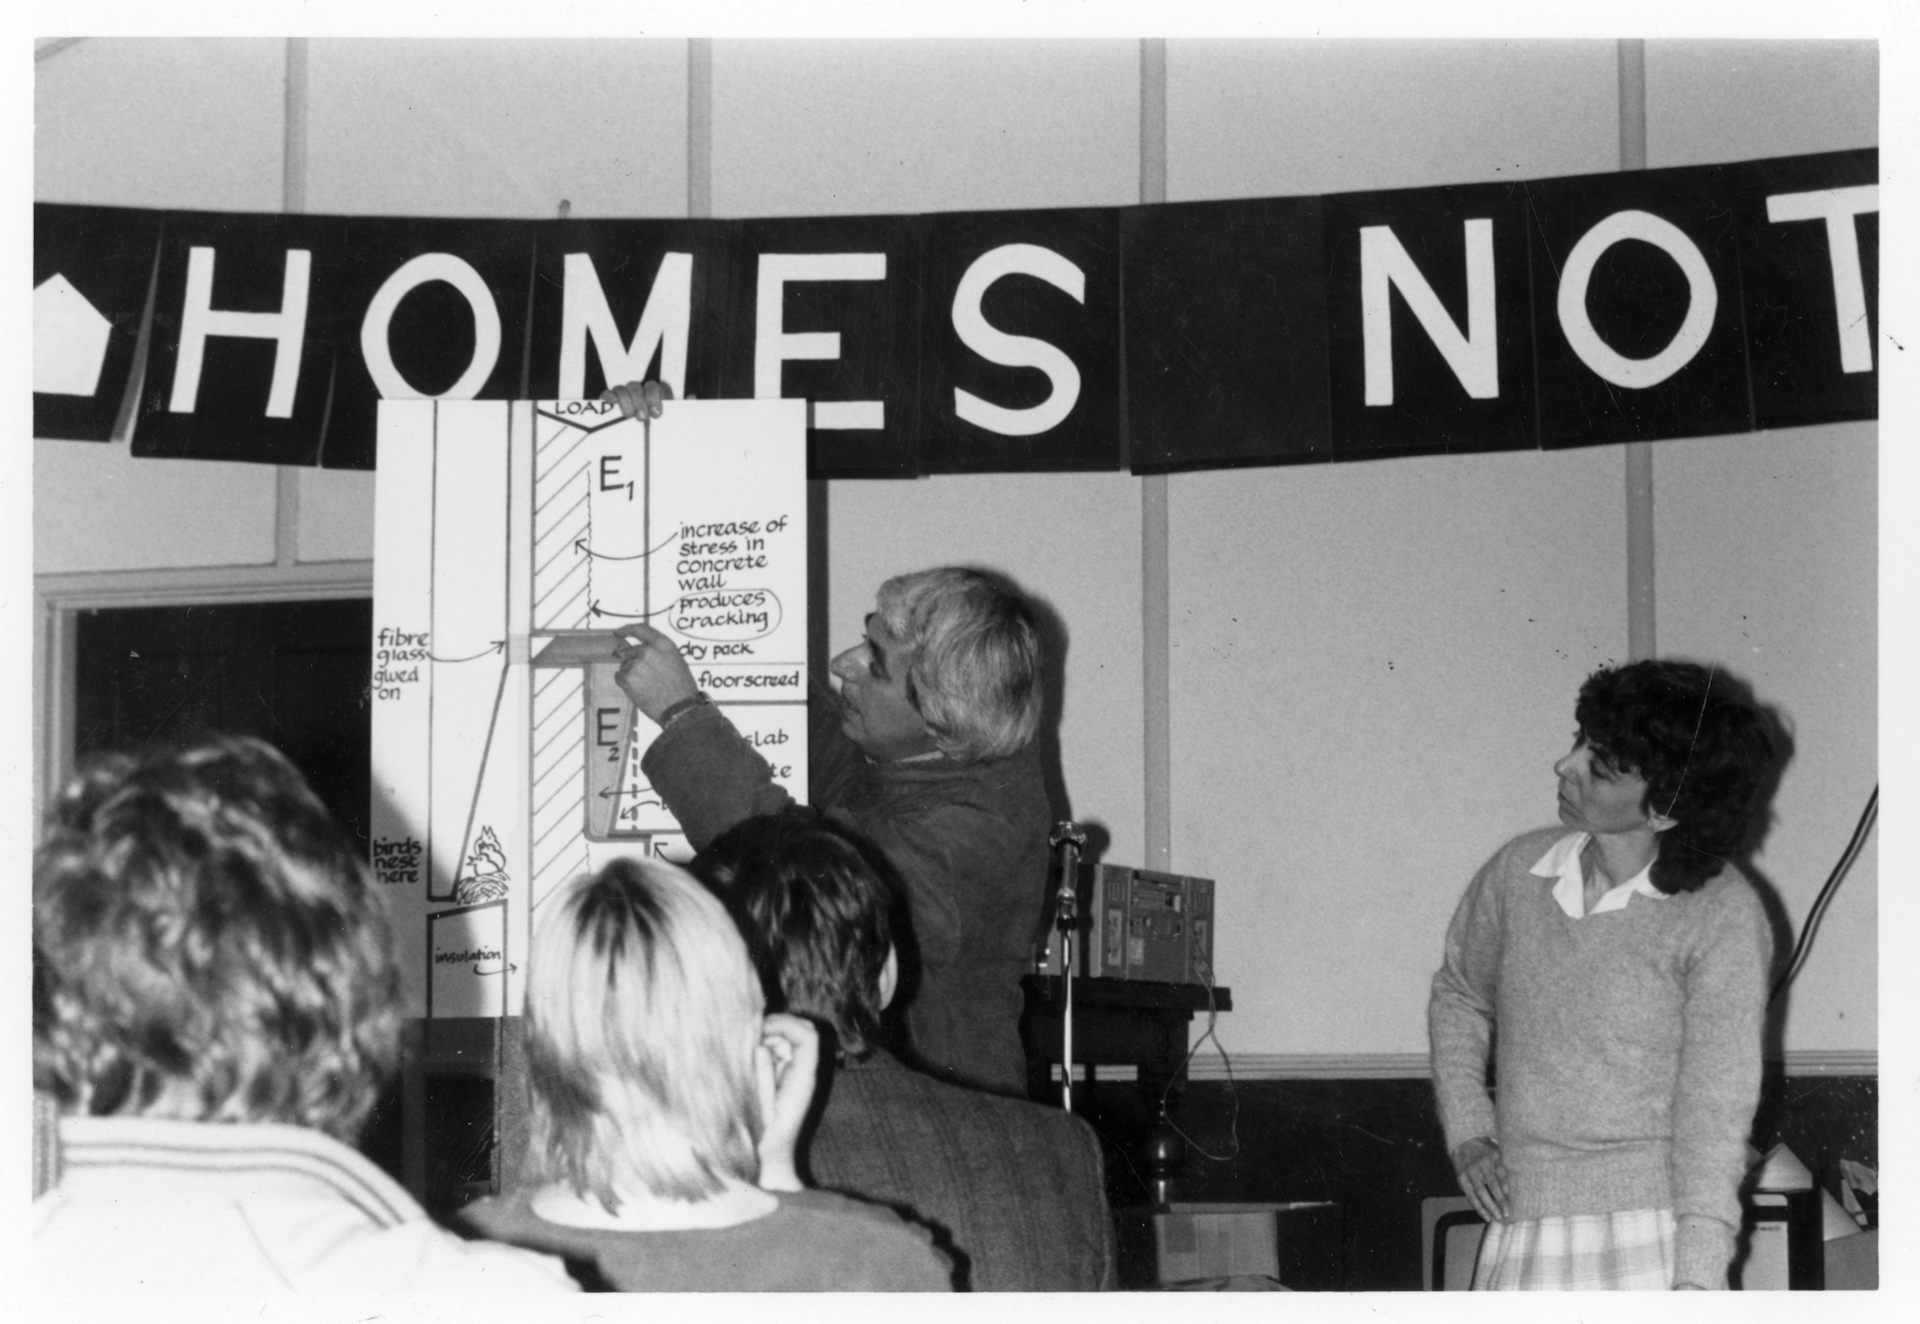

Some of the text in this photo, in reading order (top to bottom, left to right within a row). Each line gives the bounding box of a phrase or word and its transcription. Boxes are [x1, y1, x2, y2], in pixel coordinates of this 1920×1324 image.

[169, 183, 1878, 436] HOMES NOT
[555, 401, 615, 415] LOAD
[680, 514, 788, 539] increase of
[679, 536, 765, 557] stress in
[676, 554, 769, 575] concrete
[678, 573, 727, 591] wall
[679, 591, 766, 615] produces
[676, 609, 769, 633] cracking
[377, 626, 430, 648] fibre
[376, 648, 426, 669] glass
[679, 640, 755, 661] dry pack
[373, 665, 419, 690] glued
[378, 686, 401, 700] on
[373, 836, 422, 857] birds
[374, 854, 420, 870] nest
[376, 868, 420, 885] here
[435, 945, 502, 964] insulation
